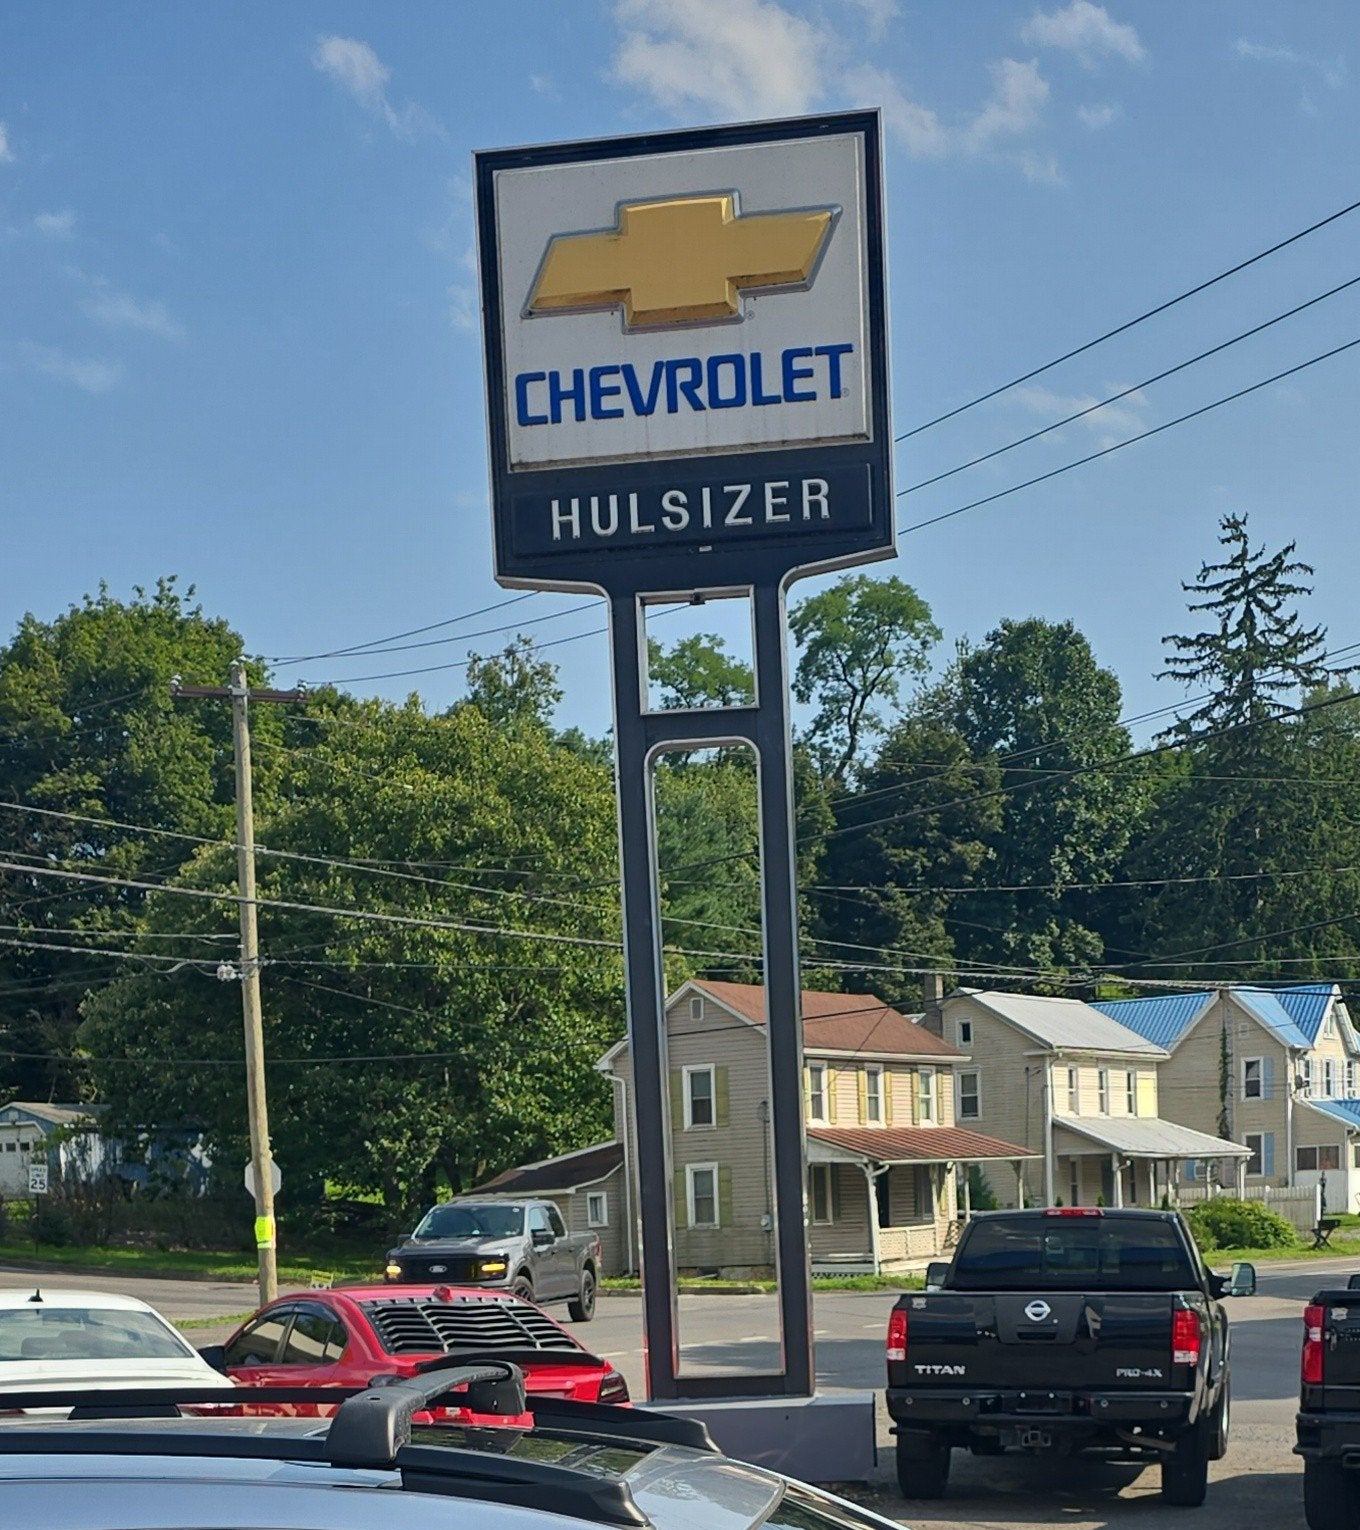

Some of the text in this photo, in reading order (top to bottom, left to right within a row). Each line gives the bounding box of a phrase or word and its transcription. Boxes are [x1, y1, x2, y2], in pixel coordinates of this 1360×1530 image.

[514, 343, 854, 427] CHEVROLET
[550, 477, 830, 541] HULSIZER
[30, 1178, 46, 1190] 25
[914, 1364, 966, 1375] TITAN
[1116, 1367, 1164, 1378] PRO-4X
